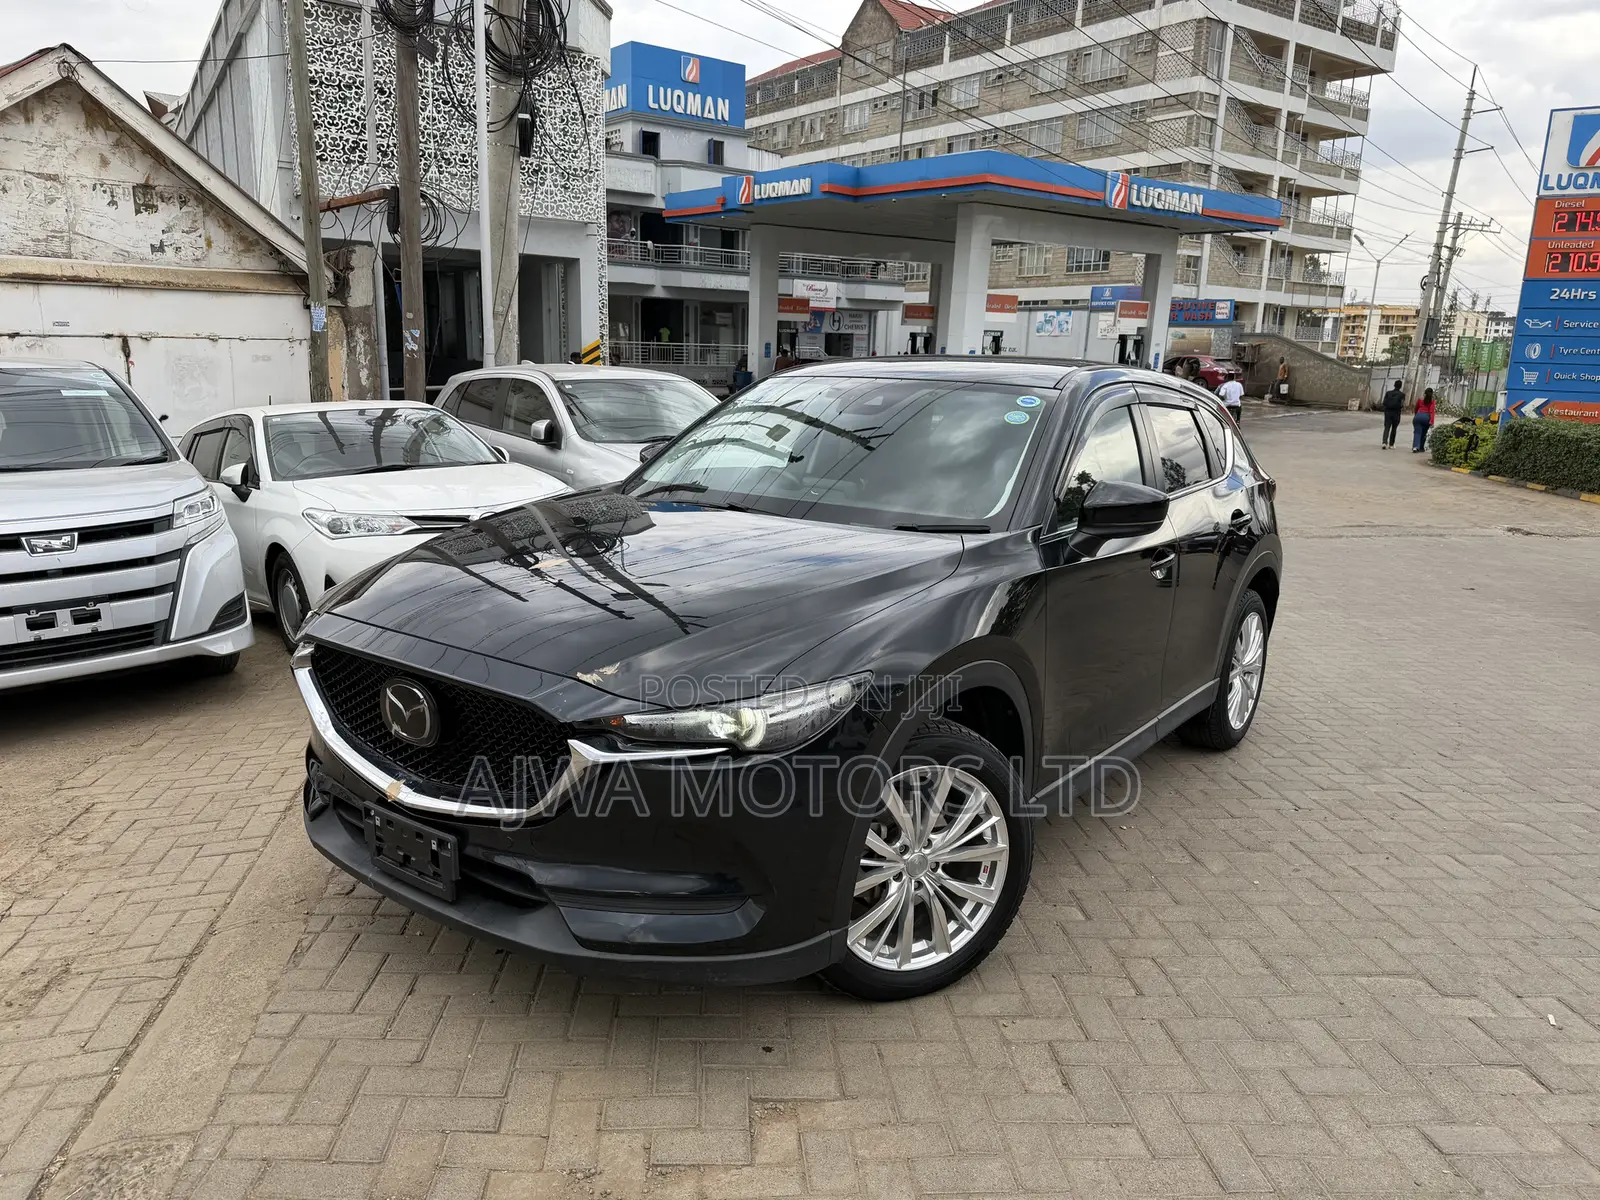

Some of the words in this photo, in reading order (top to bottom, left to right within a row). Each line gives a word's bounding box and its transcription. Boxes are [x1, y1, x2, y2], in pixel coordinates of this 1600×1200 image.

[648, 84, 729, 121] LUQMAN
[754, 178, 812, 200] LUQMAN
[1130, 184, 1204, 215] LUQMAN
[1555, 200, 1585, 208] Diesel
[1547, 240, 1595, 249] Unleaded
[1549, 288, 1597, 300] 24Hrs
[1183, 312, 1213, 320] WASH
[1563, 319, 1599, 329] Service
[1559, 346, 1578, 355] Tyre
[1554, 372, 1577, 380] Quick
[1580, 373, 1600, 383] Shop
[1548, 407, 1599, 418] Restaurant
